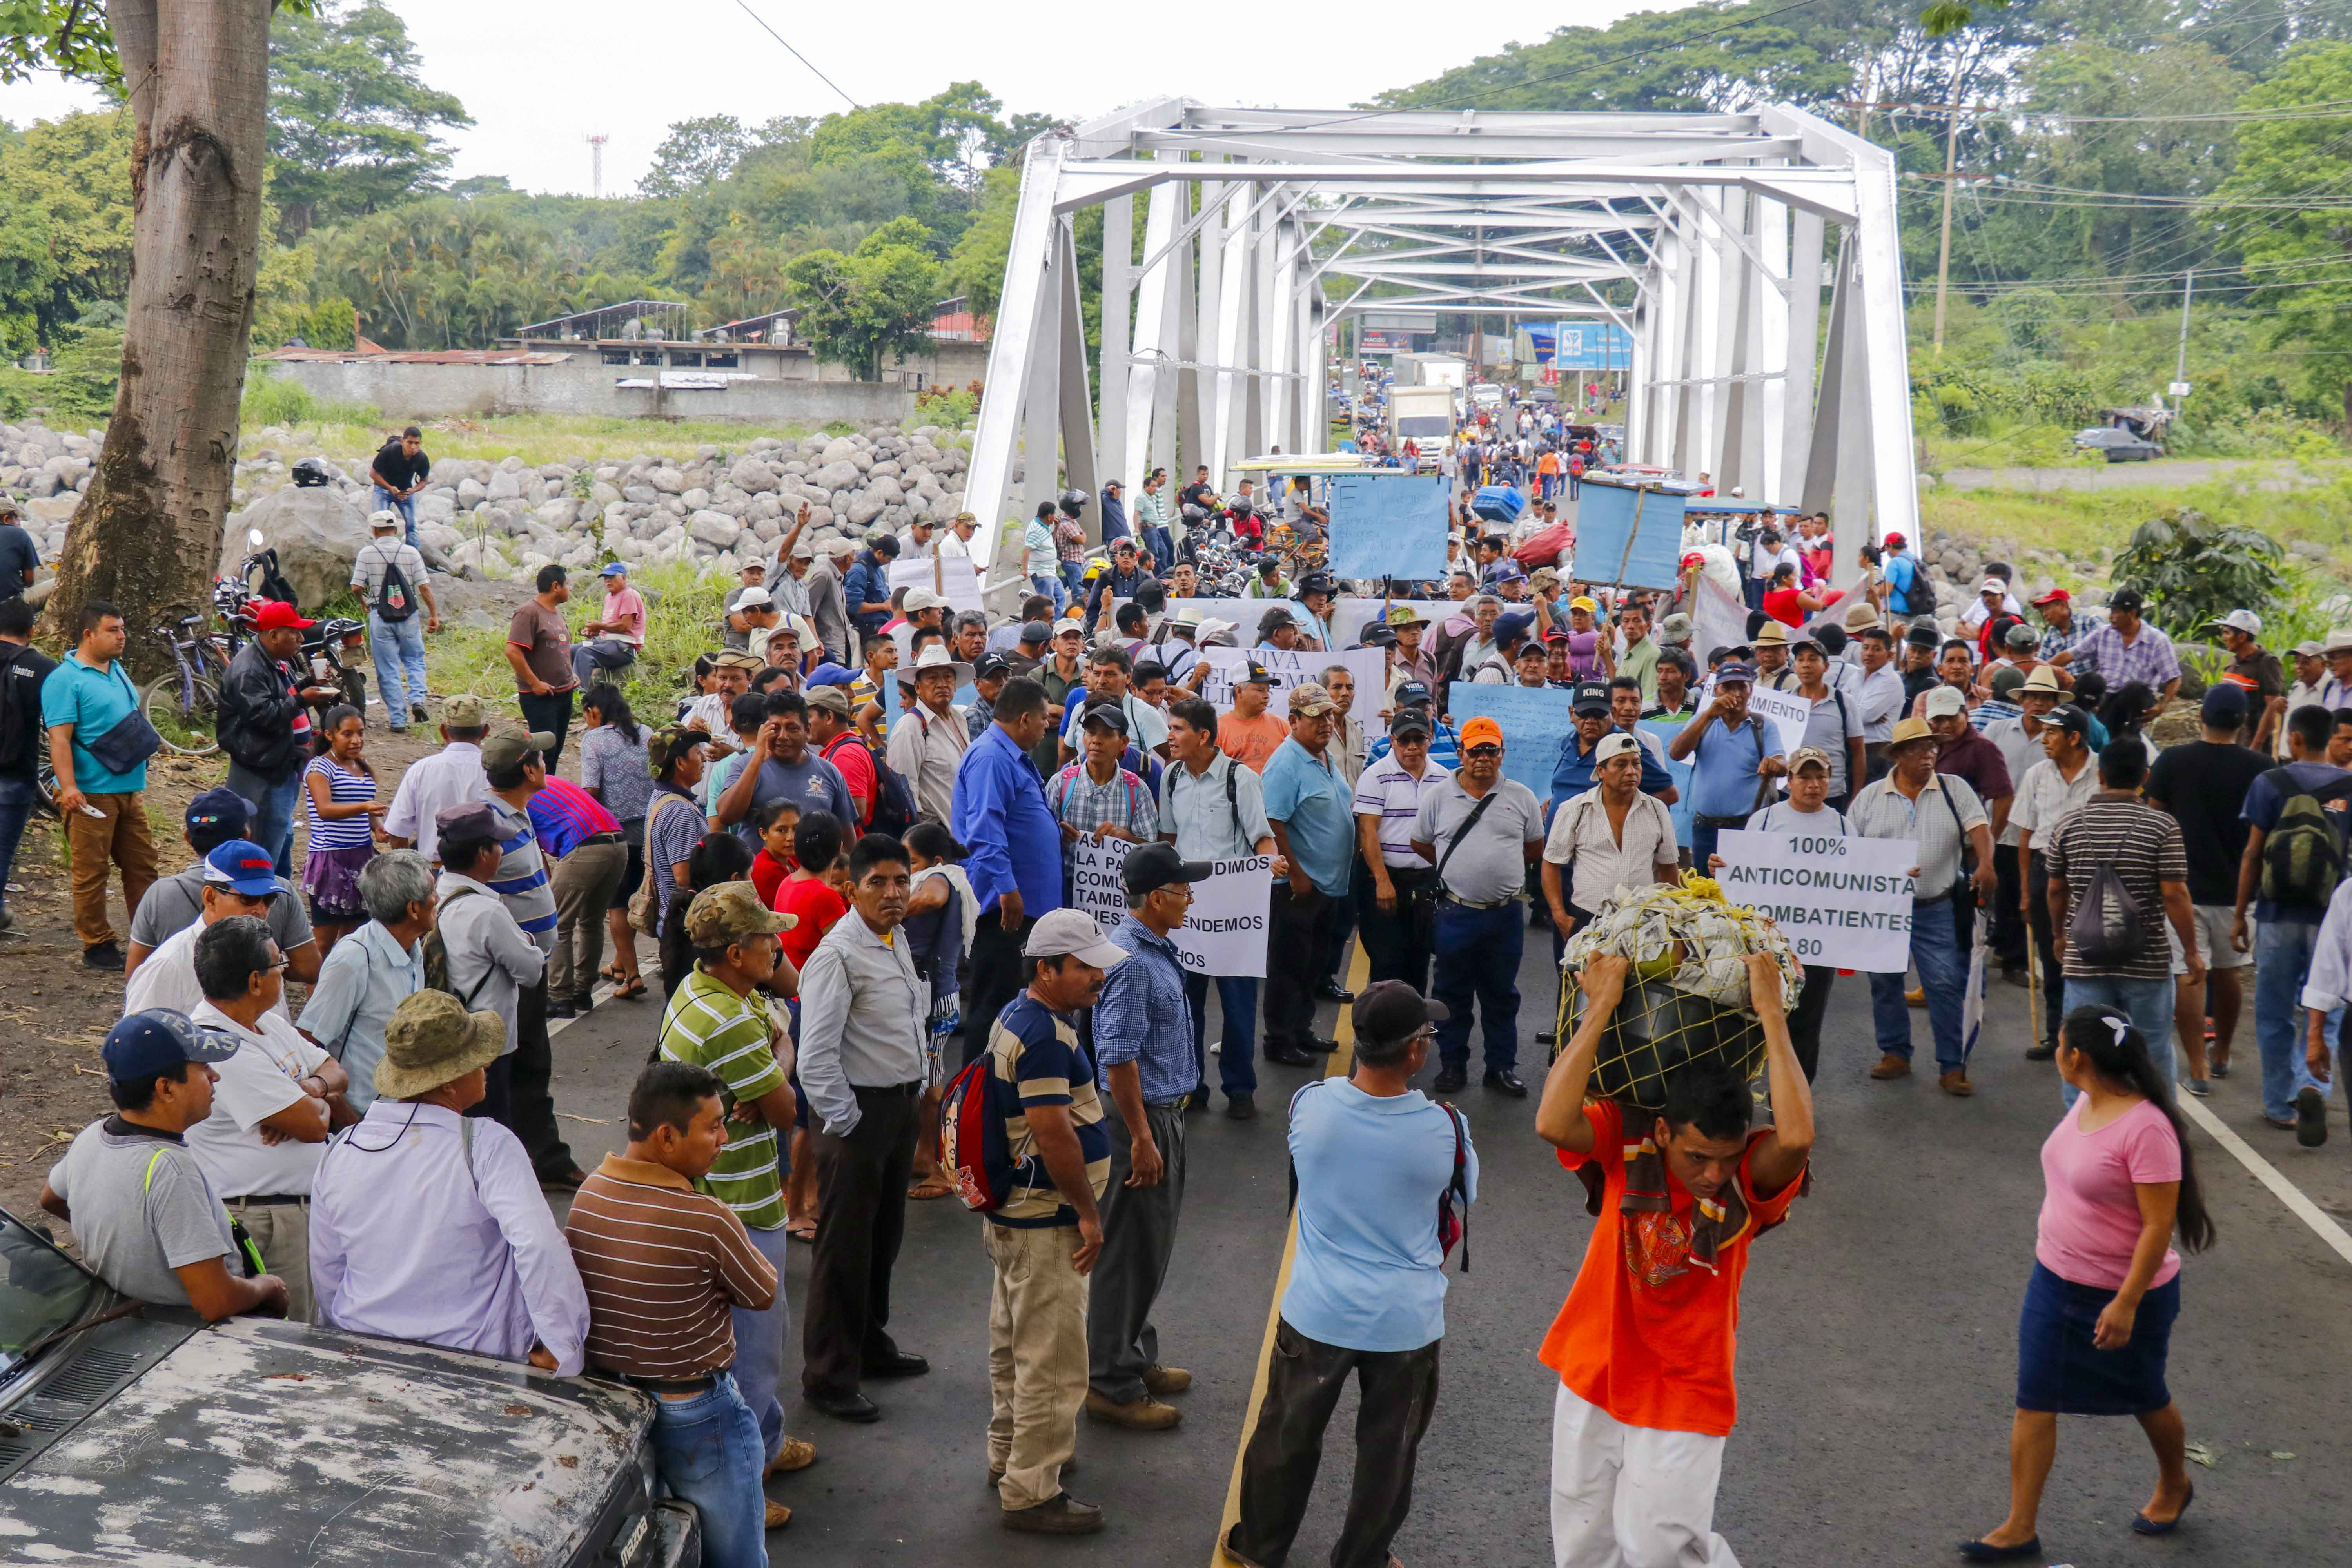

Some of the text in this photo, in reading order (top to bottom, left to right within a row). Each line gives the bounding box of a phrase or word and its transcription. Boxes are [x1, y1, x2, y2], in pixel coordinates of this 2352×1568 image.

[1245, 649, 1302, 670] VIVA
[1583, 688, 1605, 697] KING
[1079, 833, 1105, 850] ASI
[1789, 837, 1846, 855] 100%
[1076, 851, 1097, 867] LA
[1729, 865, 1916, 895] ANTICOMUNISTA
[1797, 938, 1822, 956] 80
[160, 1010, 236, 1051] TEXAS
